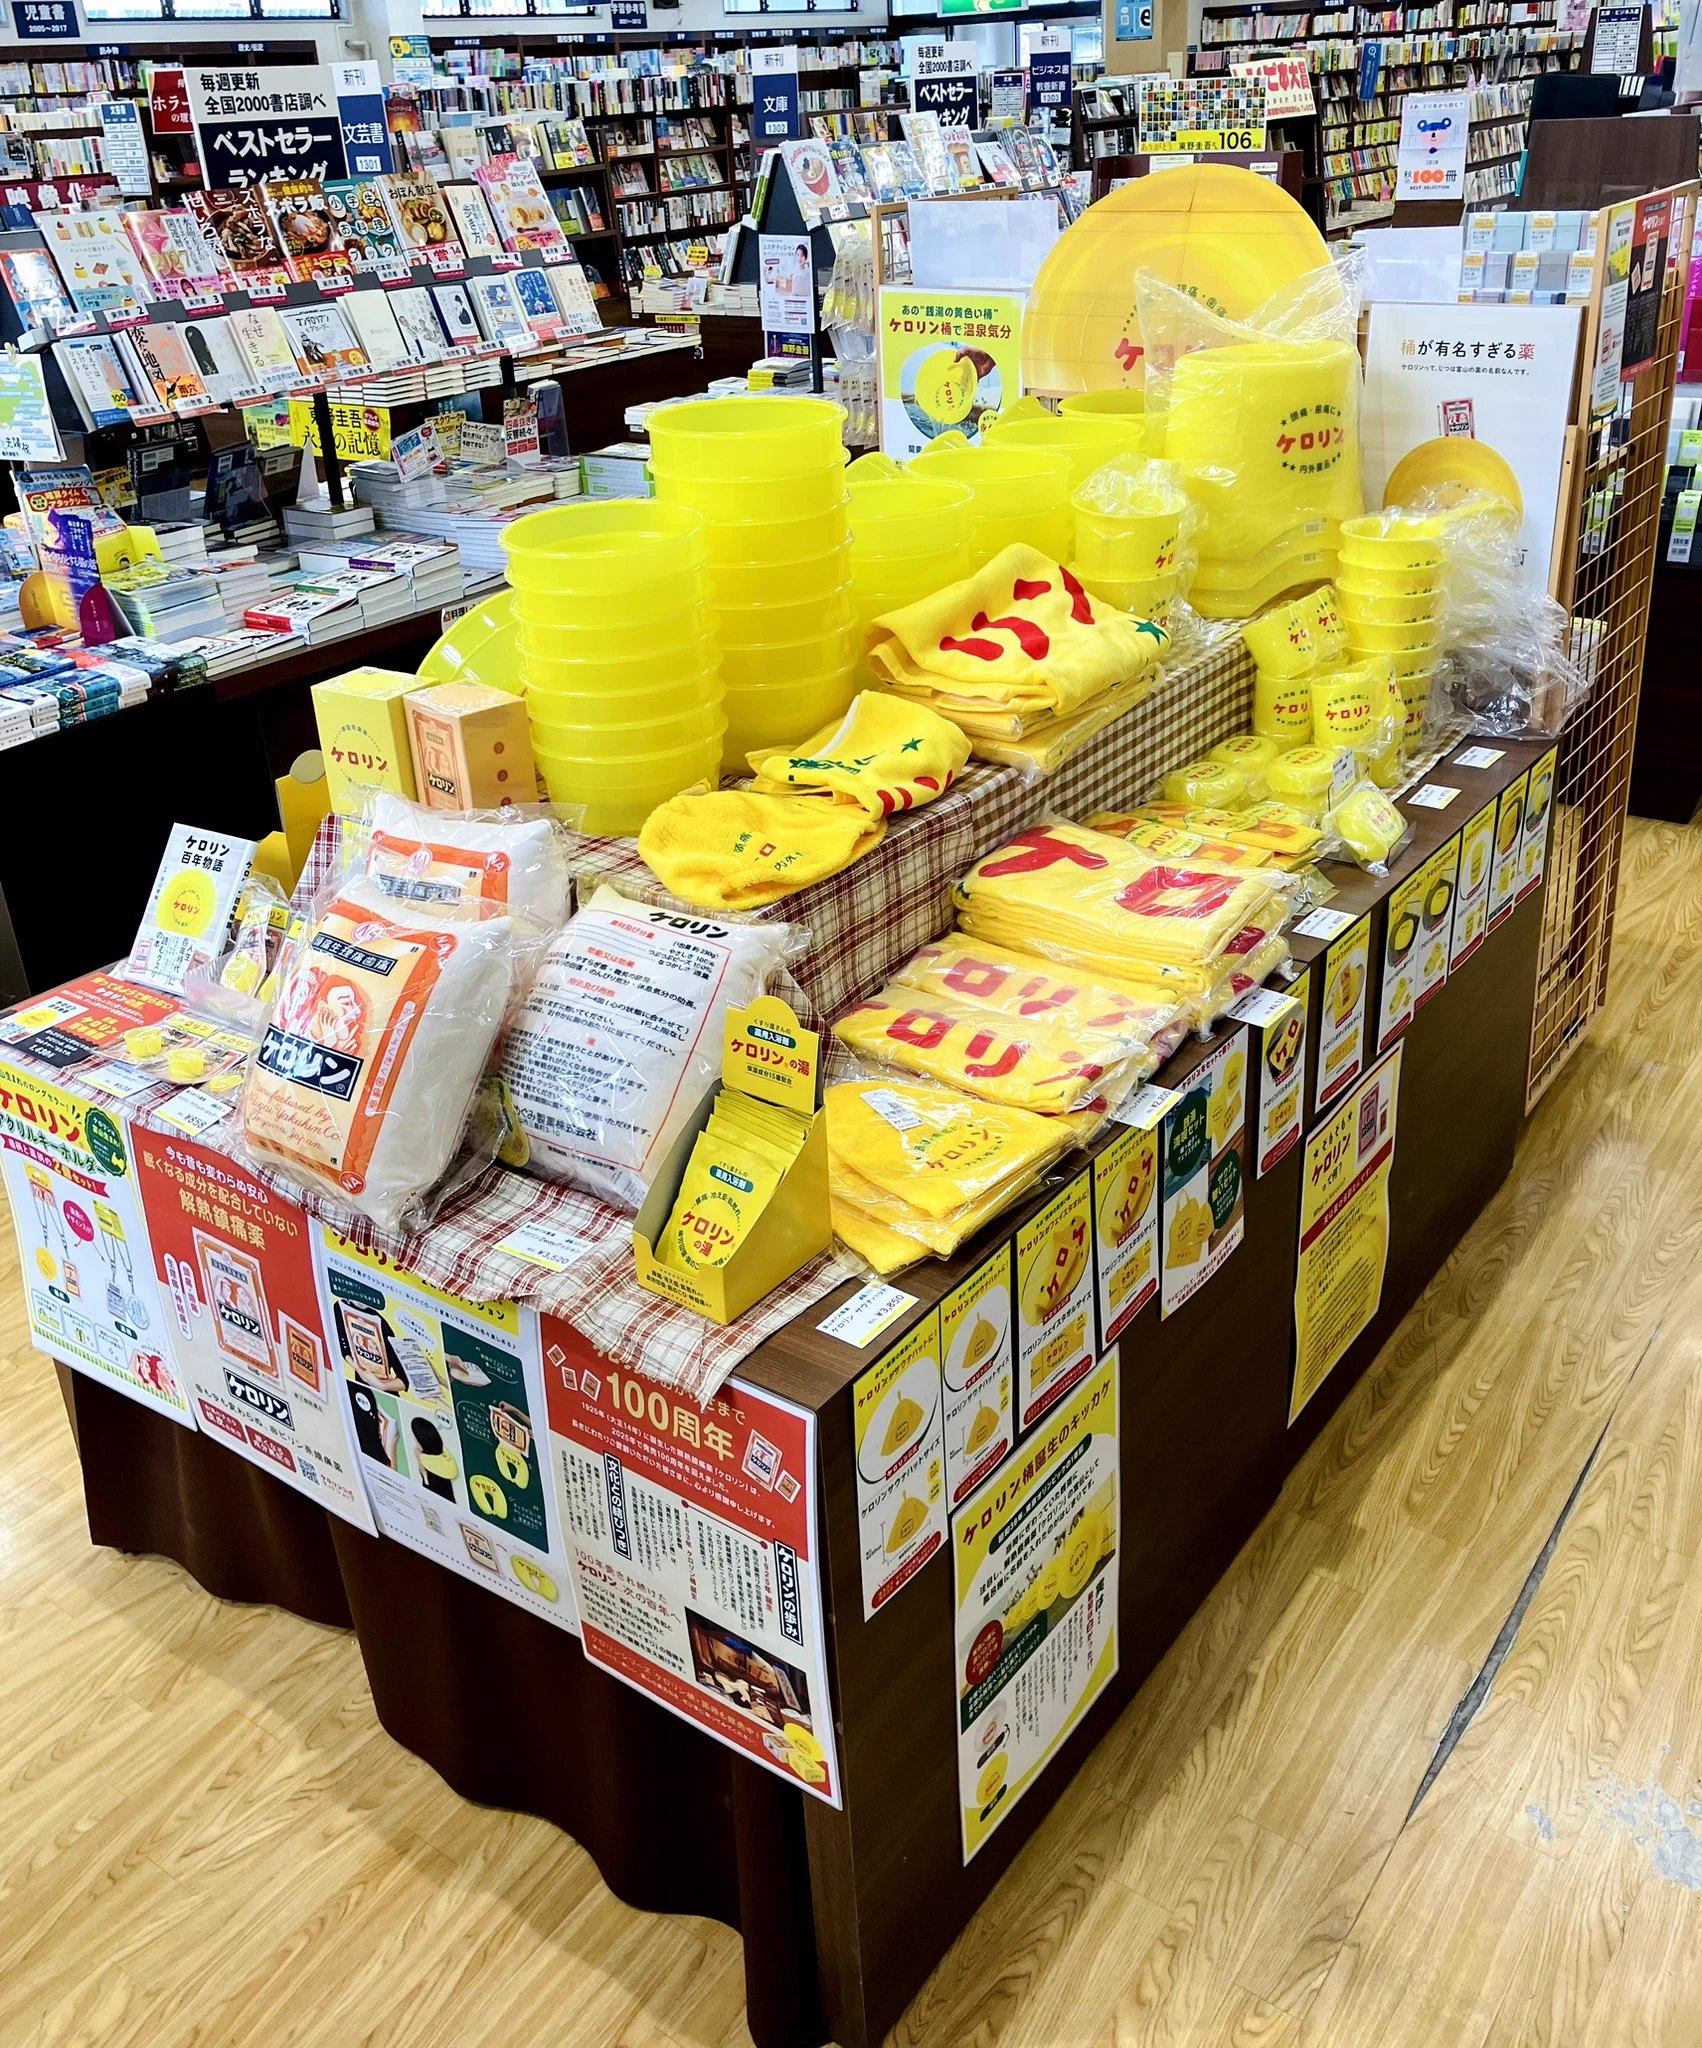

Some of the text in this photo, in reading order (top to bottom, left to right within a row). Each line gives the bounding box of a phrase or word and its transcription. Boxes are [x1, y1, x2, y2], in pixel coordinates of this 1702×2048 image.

[24, 4, 66, 20] 児童書
[1040, 34, 1060, 47] 新刊
[763, 54, 785, 67] 新刊
[1032, 64, 1070, 76] ビジネス書
[199, 73, 260, 92] 毎週更新
[342, 67, 366, 86] 新刊
[919, 82, 973, 103] ベストセラー
[204, 91, 328, 116] 全国2000書店調べ
[762, 94, 789, 114] 文庫
[342, 122, 385, 146] 文芸書
[767, 122, 787, 134] 1302
[213, 125, 333, 158] ベストセラー
[1218, 131, 1253, 150] 106
[357, 158, 381, 171] 1301
[344, 276, 350, 285] 5
[403, 268, 409, 276] 6
[212, 294, 220, 304] 3
[276, 286, 284, 294] 4
[136, 306, 145, 315] 2
[247, 312, 265, 338] なぜ
[889, 317, 1012, 339] ケロリン桶で温泉気分
[414, 356, 421, 364] 6
[1400, 338, 1535, 361] 桶が有名すぎる薬
[260, 385, 267, 394] 3
[314, 375, 321, 384] 4
[159, 404, 166, 413] 1
[308, 405, 362, 430] 東圭吾
[302, 426, 380, 456] 永の記憶
[1275, 427, 1344, 455] ケロリン
[1325, 704, 1371, 721] ケロリン
[330, 745, 389, 772] ケロリン
[428, 774, 456, 794] ケロリン
[185, 834, 230, 857] ケロリン
[180, 850, 225, 873] 百年物語
[173, 900, 200, 915] ケロリン
[649, 911, 730, 939] ケロリン
[1311, 1132, 1352, 1187] ケロリン
[165, 1145, 269, 1204] 今も昔も変わらぬ安心
[143, 1151, 299, 1237] 眠くなる成分を配合していない
[179, 1189, 267, 1251] 解熱鎮痛薬
[681, 1209, 735, 1246] ケロリン
[537, 1249, 570, 1265] ¥3,520
[693, 1239, 714, 1257] の湯
[874, 1293, 906, 1317] ¥3,850
[220, 1305, 262, 1334] ケロリン
[228, 1375, 290, 1422] ケロリン
[605, 1371, 735, 1462] 100周年
[962, 1378, 1112, 1546] ケロリン桶誕生のキッカケ
[778, 1547, 799, 1638] ケロリンの歩み
